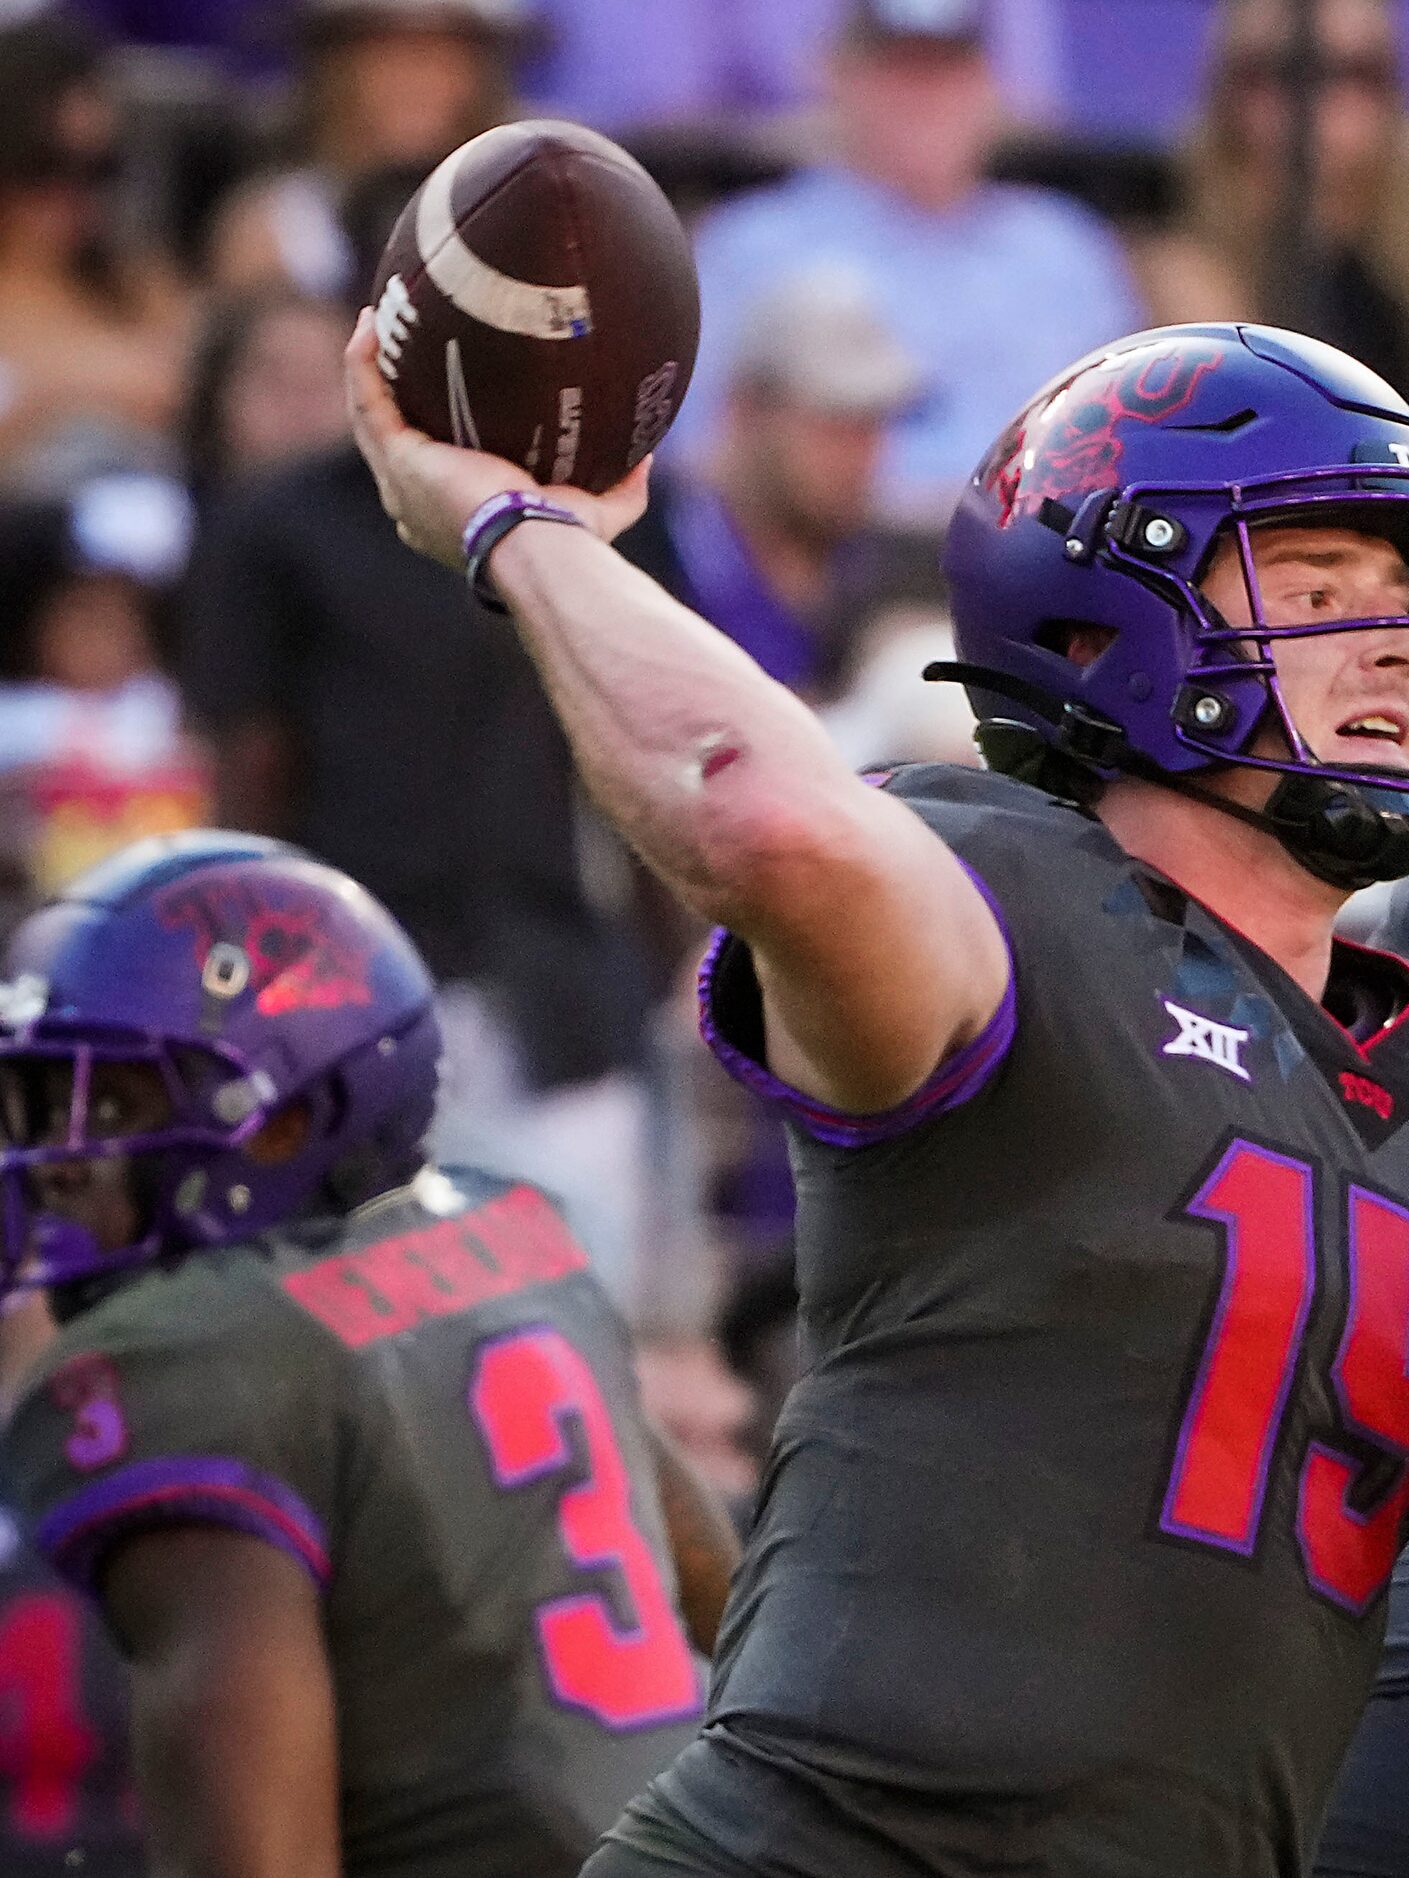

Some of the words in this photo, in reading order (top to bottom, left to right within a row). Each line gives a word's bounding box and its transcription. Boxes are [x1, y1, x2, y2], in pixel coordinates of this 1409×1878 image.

[1162, 1000, 1251, 1081] XII
[50, 1350, 128, 1470] 3
[468, 1322, 704, 1734] 3
